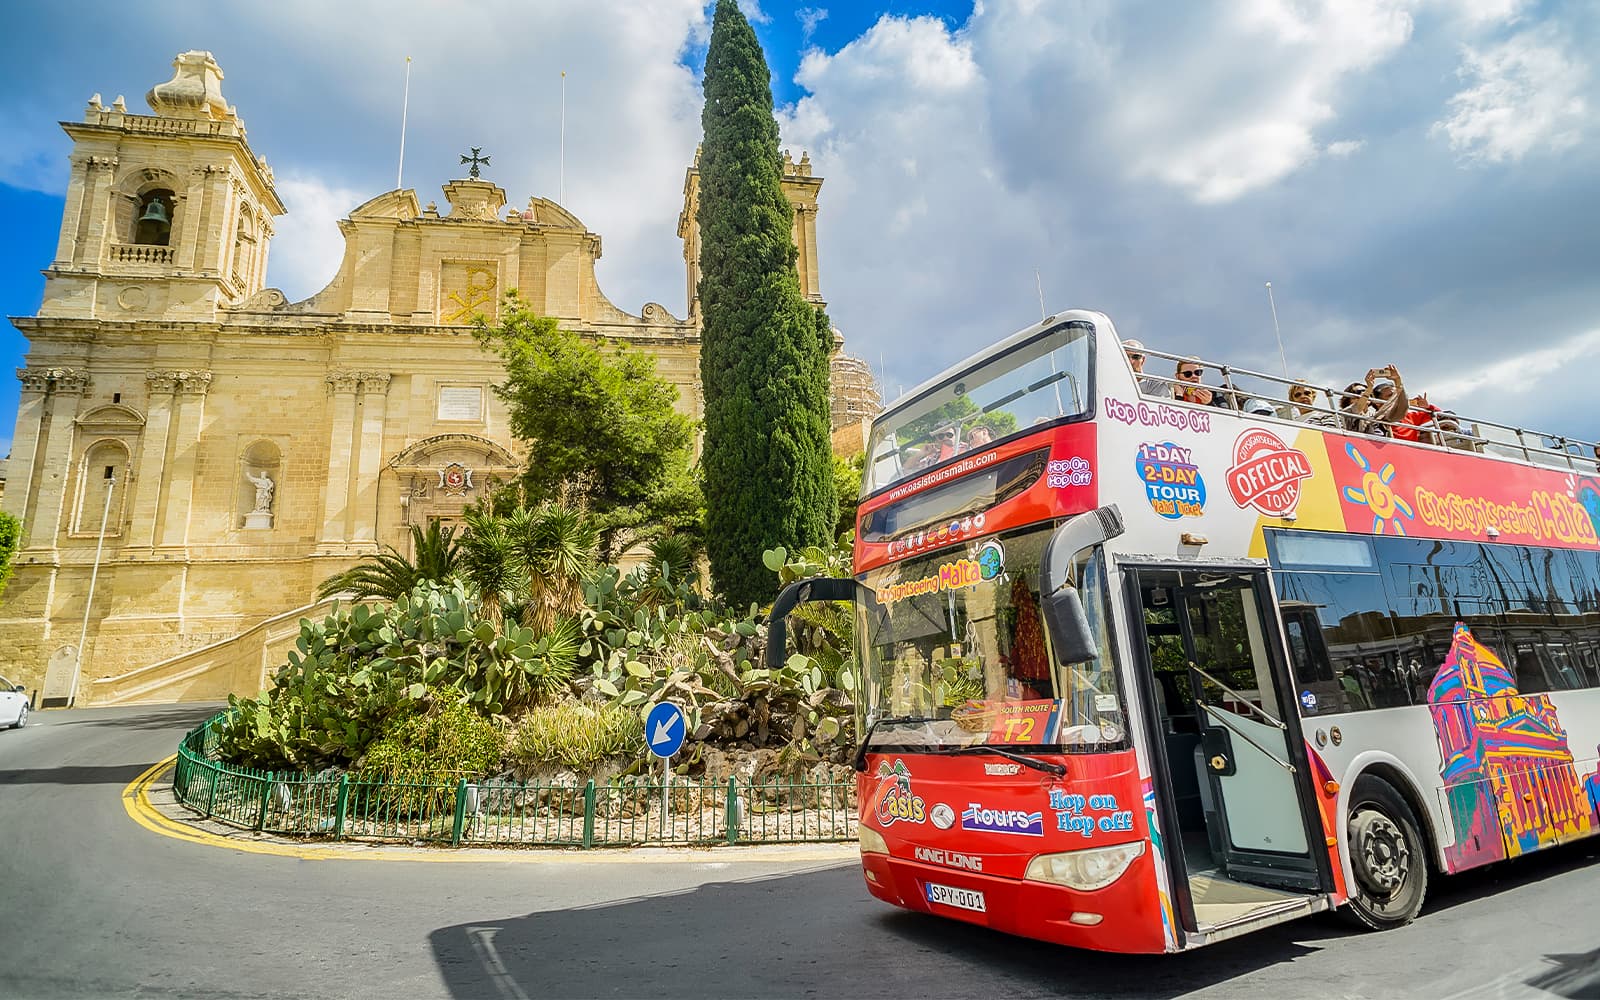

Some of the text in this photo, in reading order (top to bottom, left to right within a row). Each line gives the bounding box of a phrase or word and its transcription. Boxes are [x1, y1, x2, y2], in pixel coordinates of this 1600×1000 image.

[1105, 397, 1210, 433] Hop On Hop Off
[1048, 457, 1089, 474] Hop On
[1139, 443, 1192, 465] 1-DAY
[889, 451, 998, 500] www.oasistoursmalta.com
[1047, 471, 1092, 488] Hop Off
[1144, 464, 1197, 486] 2-DAY
[1236, 455, 1308, 497] OFFICIAL
[1148, 485, 1201, 502] TOUR
[1265, 484, 1297, 508] TOUR
[1531, 490, 1597, 544] Malta
[940, 559, 981, 591] Malta
[1025, 704, 1049, 713] ROUTE
[1003, 717, 1035, 742] T2
[1050, 789, 1118, 814] Hop on
[968, 803, 1031, 829] Tours
[1056, 810, 1133, 838] Hop off
[914, 847, 983, 871] KING LONG
